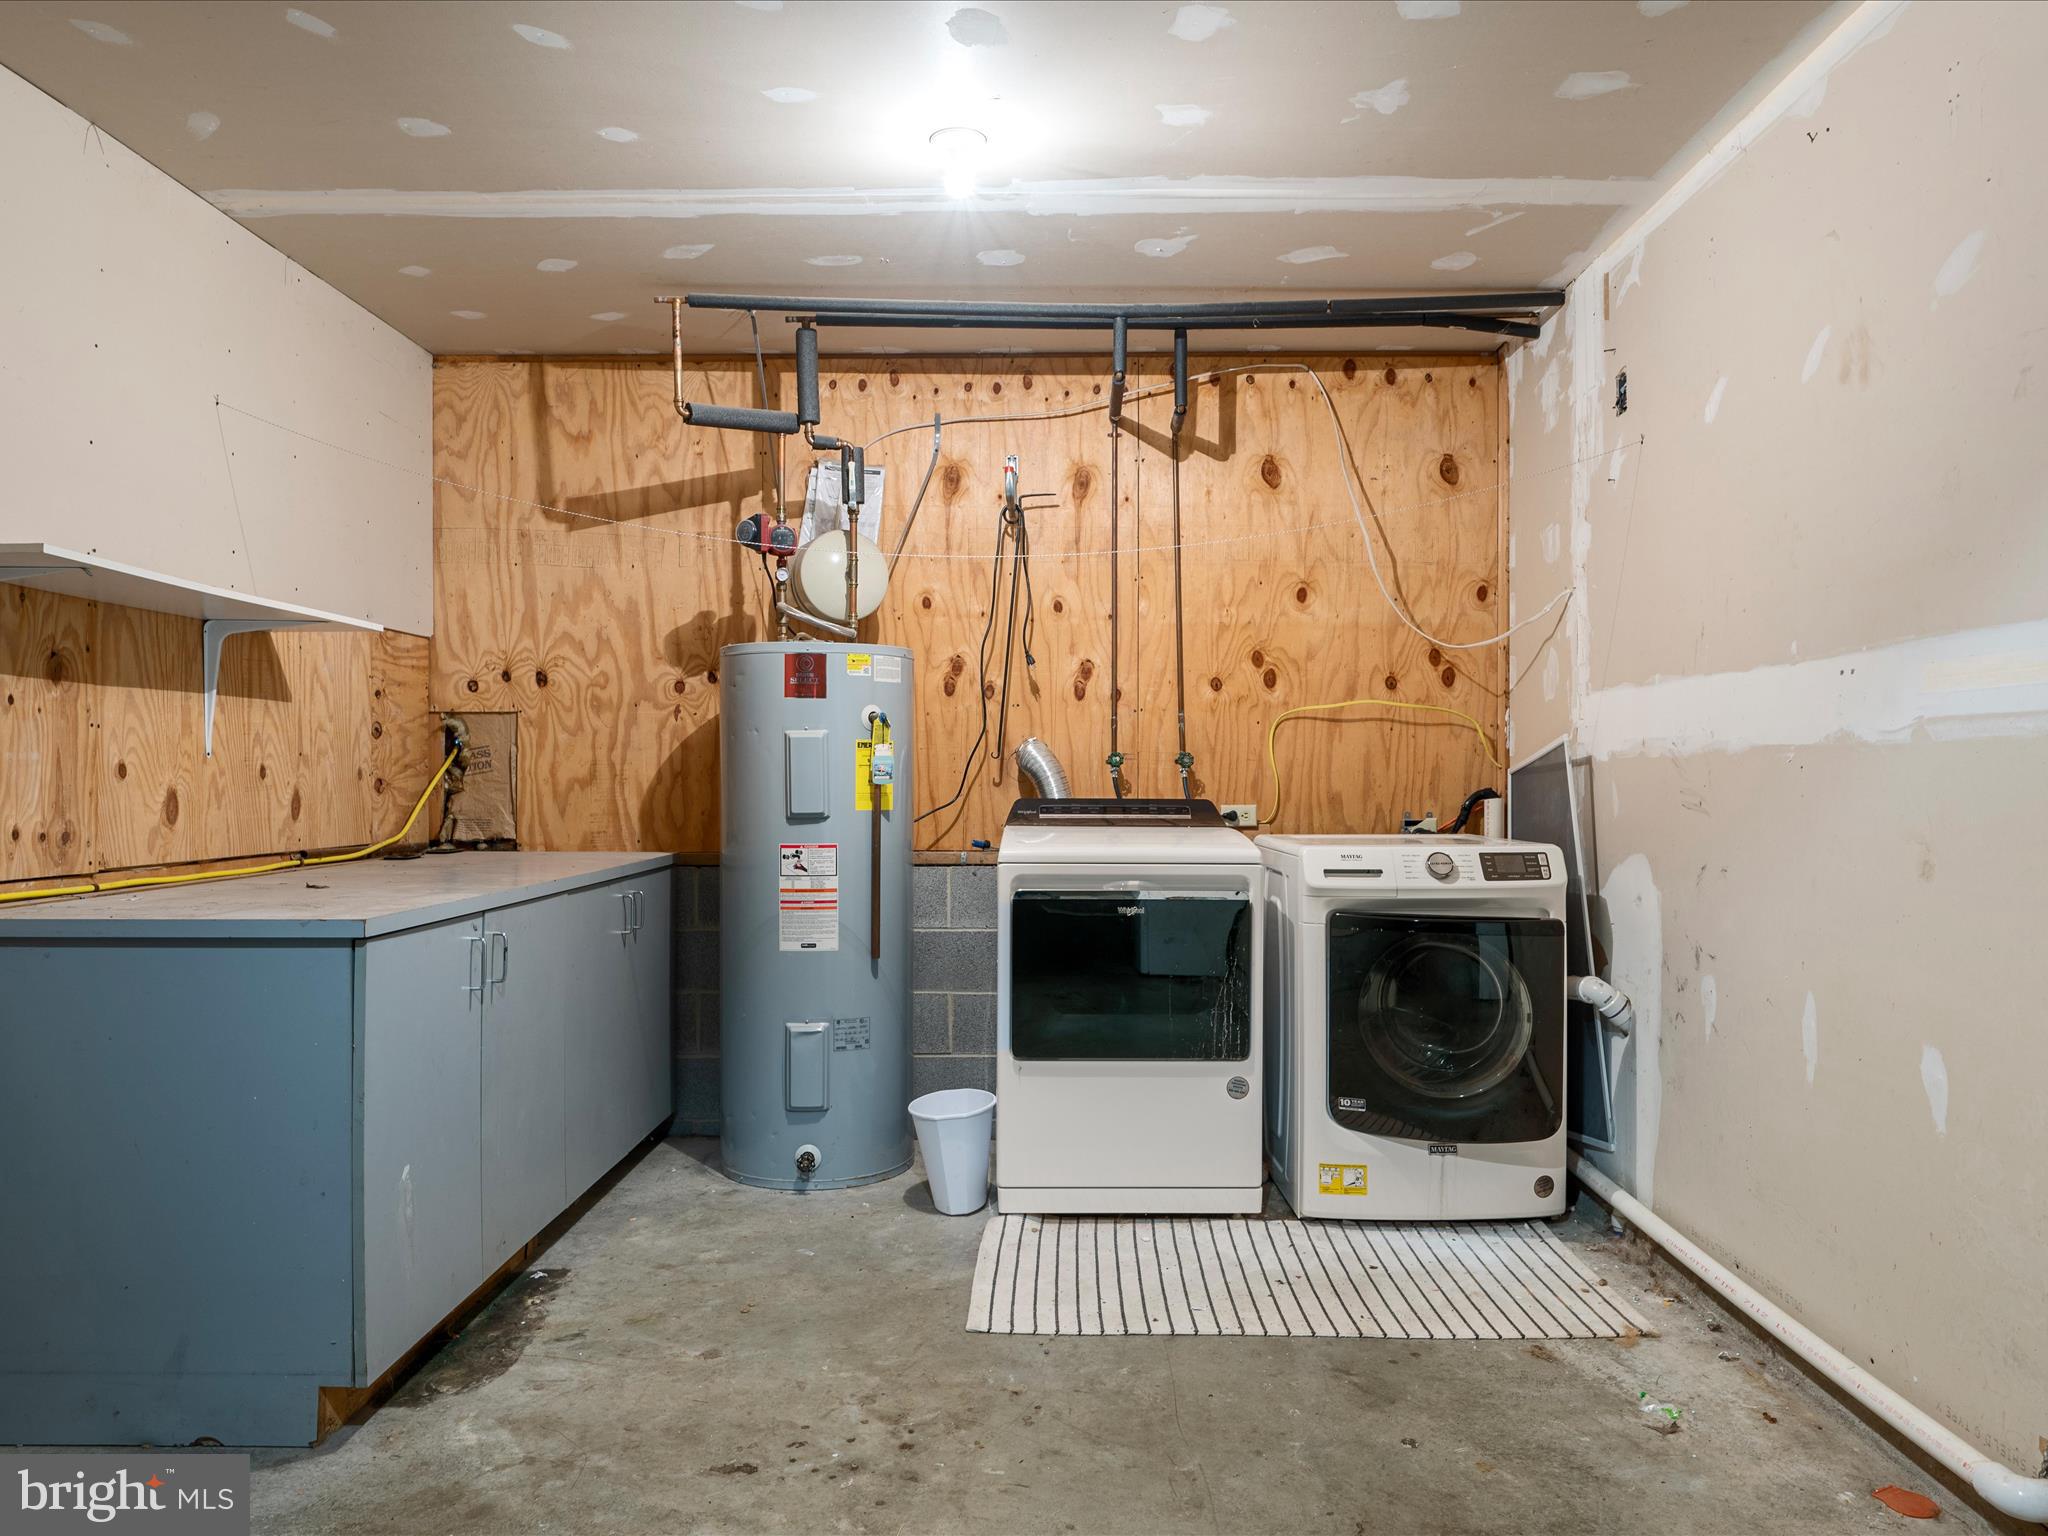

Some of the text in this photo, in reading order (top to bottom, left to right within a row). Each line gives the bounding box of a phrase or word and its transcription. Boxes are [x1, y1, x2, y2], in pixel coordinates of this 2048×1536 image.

[1117, 906, 1144, 917] Whirlpool
[1340, 1098, 1350, 1106] 10
[1430, 1145, 1457, 1153] MAYTAG
